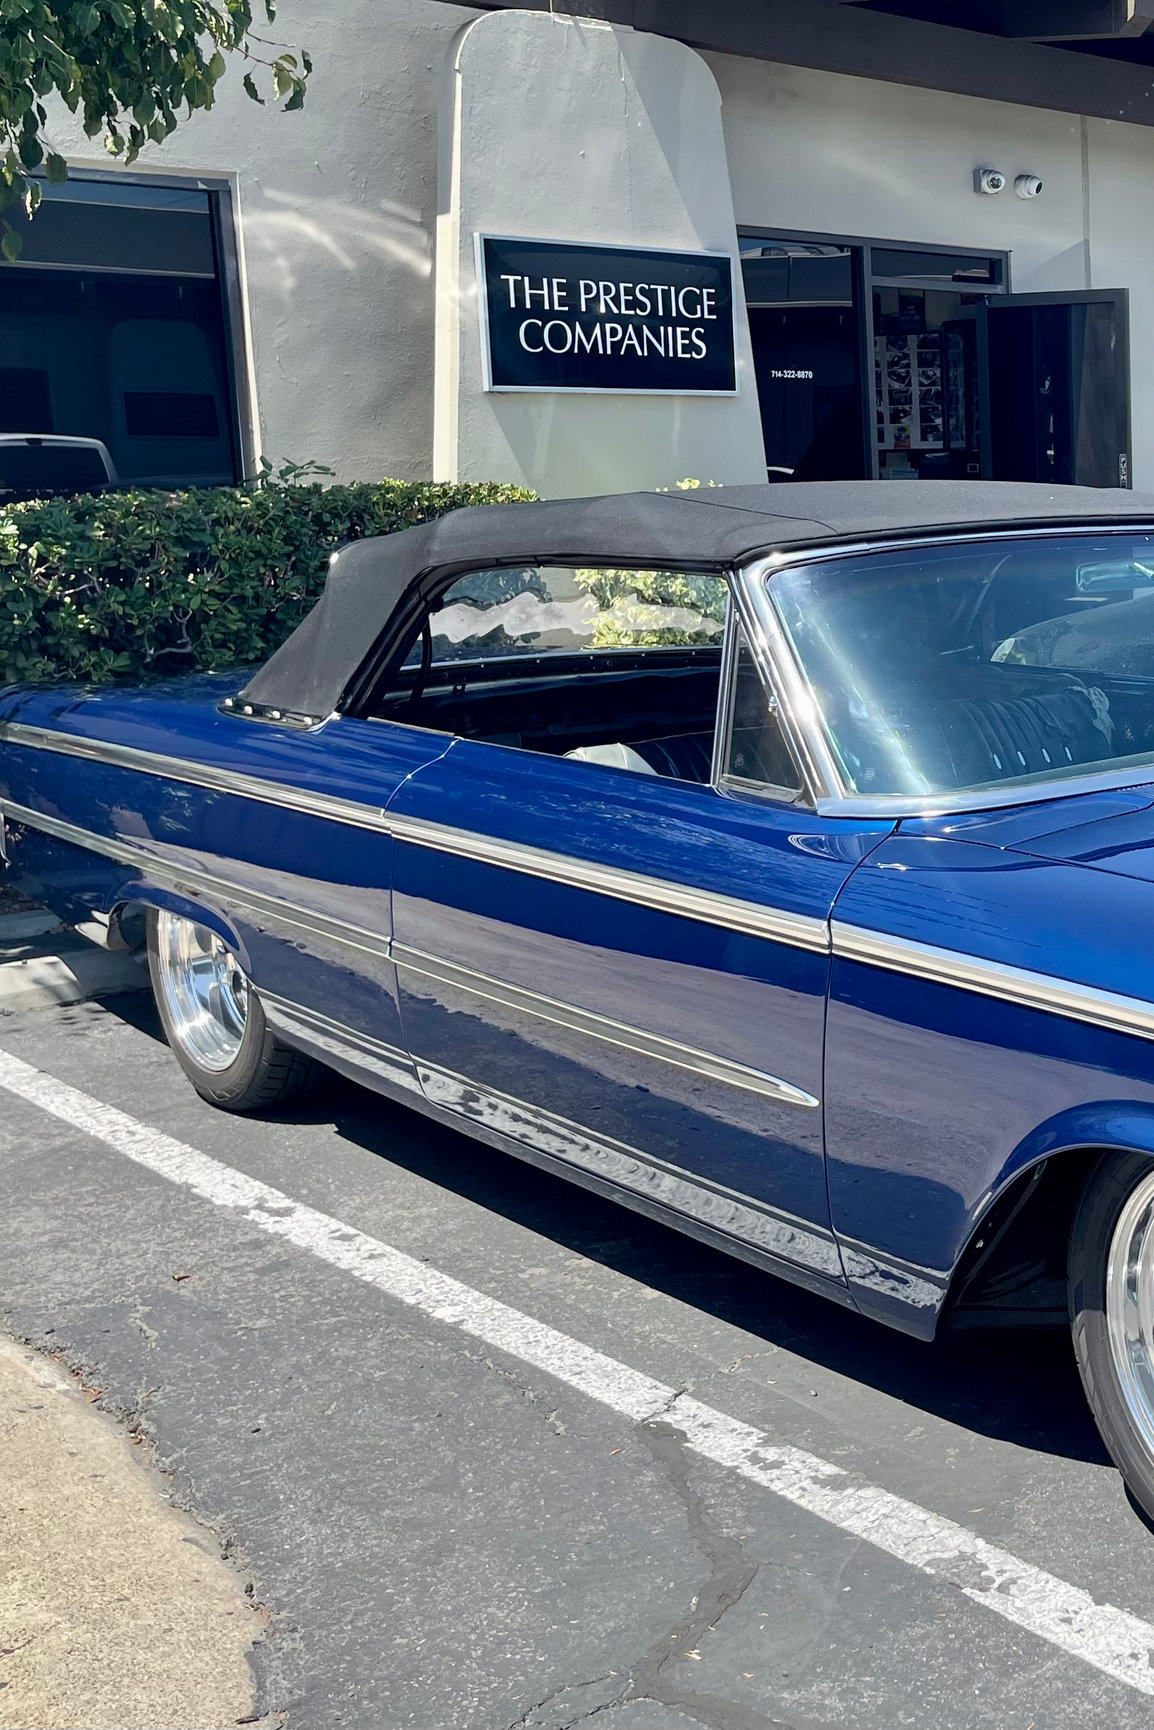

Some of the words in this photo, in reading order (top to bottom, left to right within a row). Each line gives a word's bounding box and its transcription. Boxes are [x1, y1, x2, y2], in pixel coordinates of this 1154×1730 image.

[500, 274, 569, 312] THE
[580, 280, 717, 320] PRESTIGE
[519, 319, 707, 360] COMPANIES
